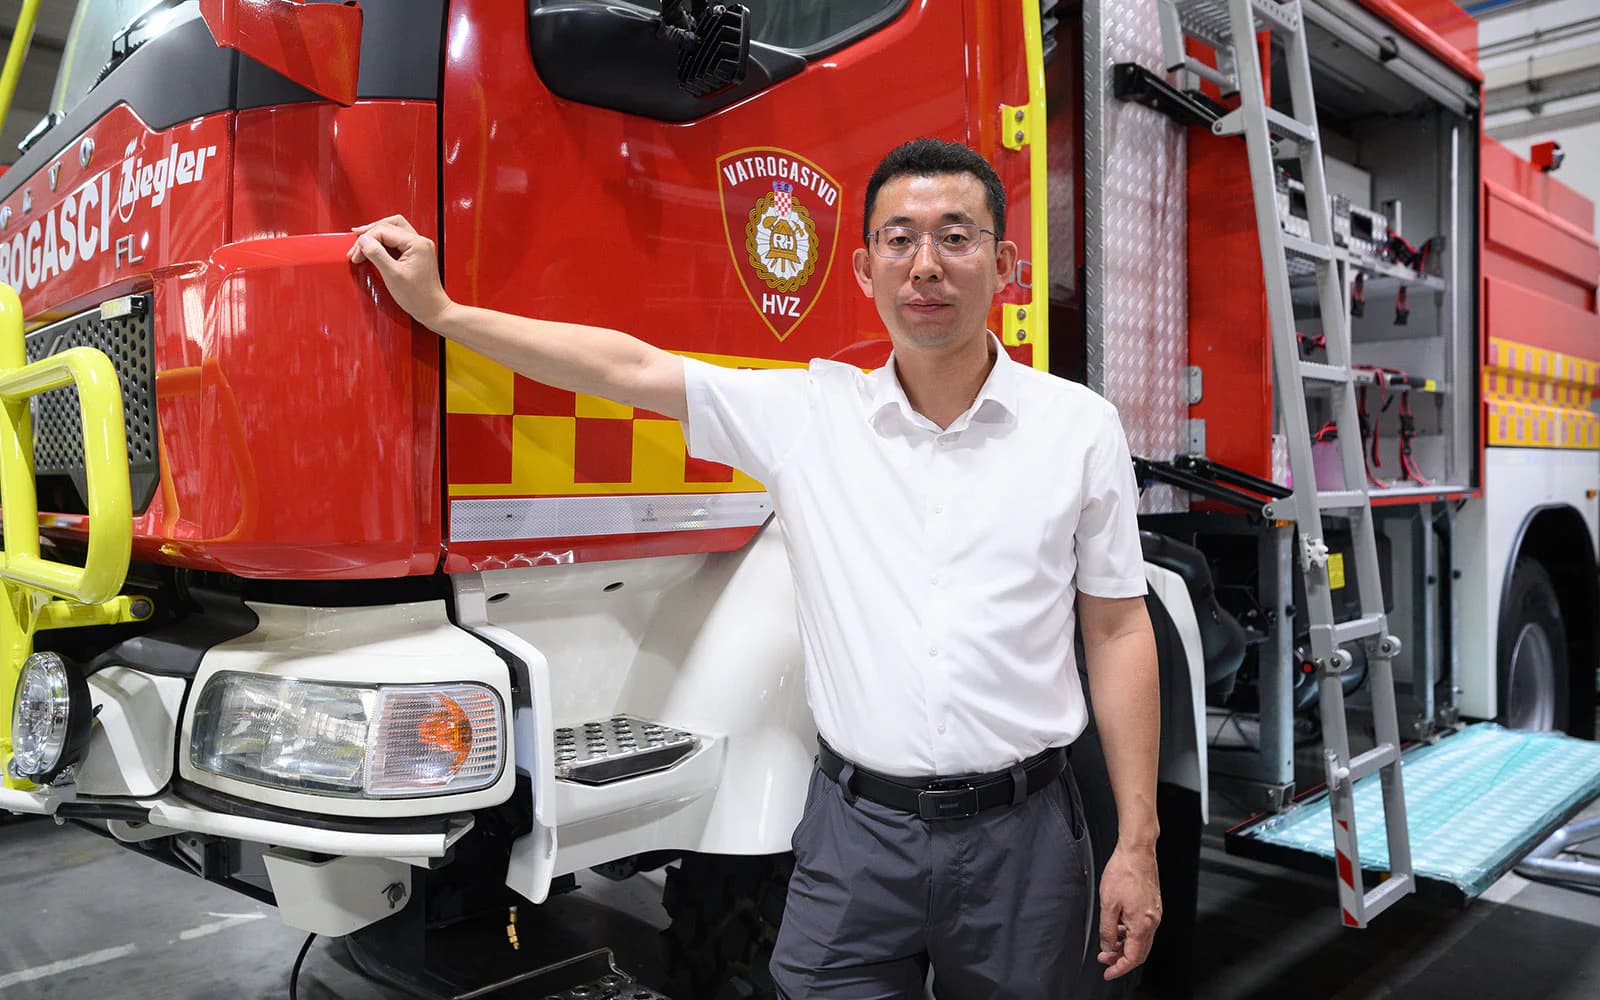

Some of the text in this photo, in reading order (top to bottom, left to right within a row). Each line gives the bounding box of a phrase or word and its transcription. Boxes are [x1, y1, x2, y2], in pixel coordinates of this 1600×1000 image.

[118, 142, 217, 222] Ziegler
[723, 156, 838, 207] VATROGASTVO
[116, 234, 144, 269] FL
[773, 234, 794, 250] RH
[762, 293, 801, 317] HVZ
